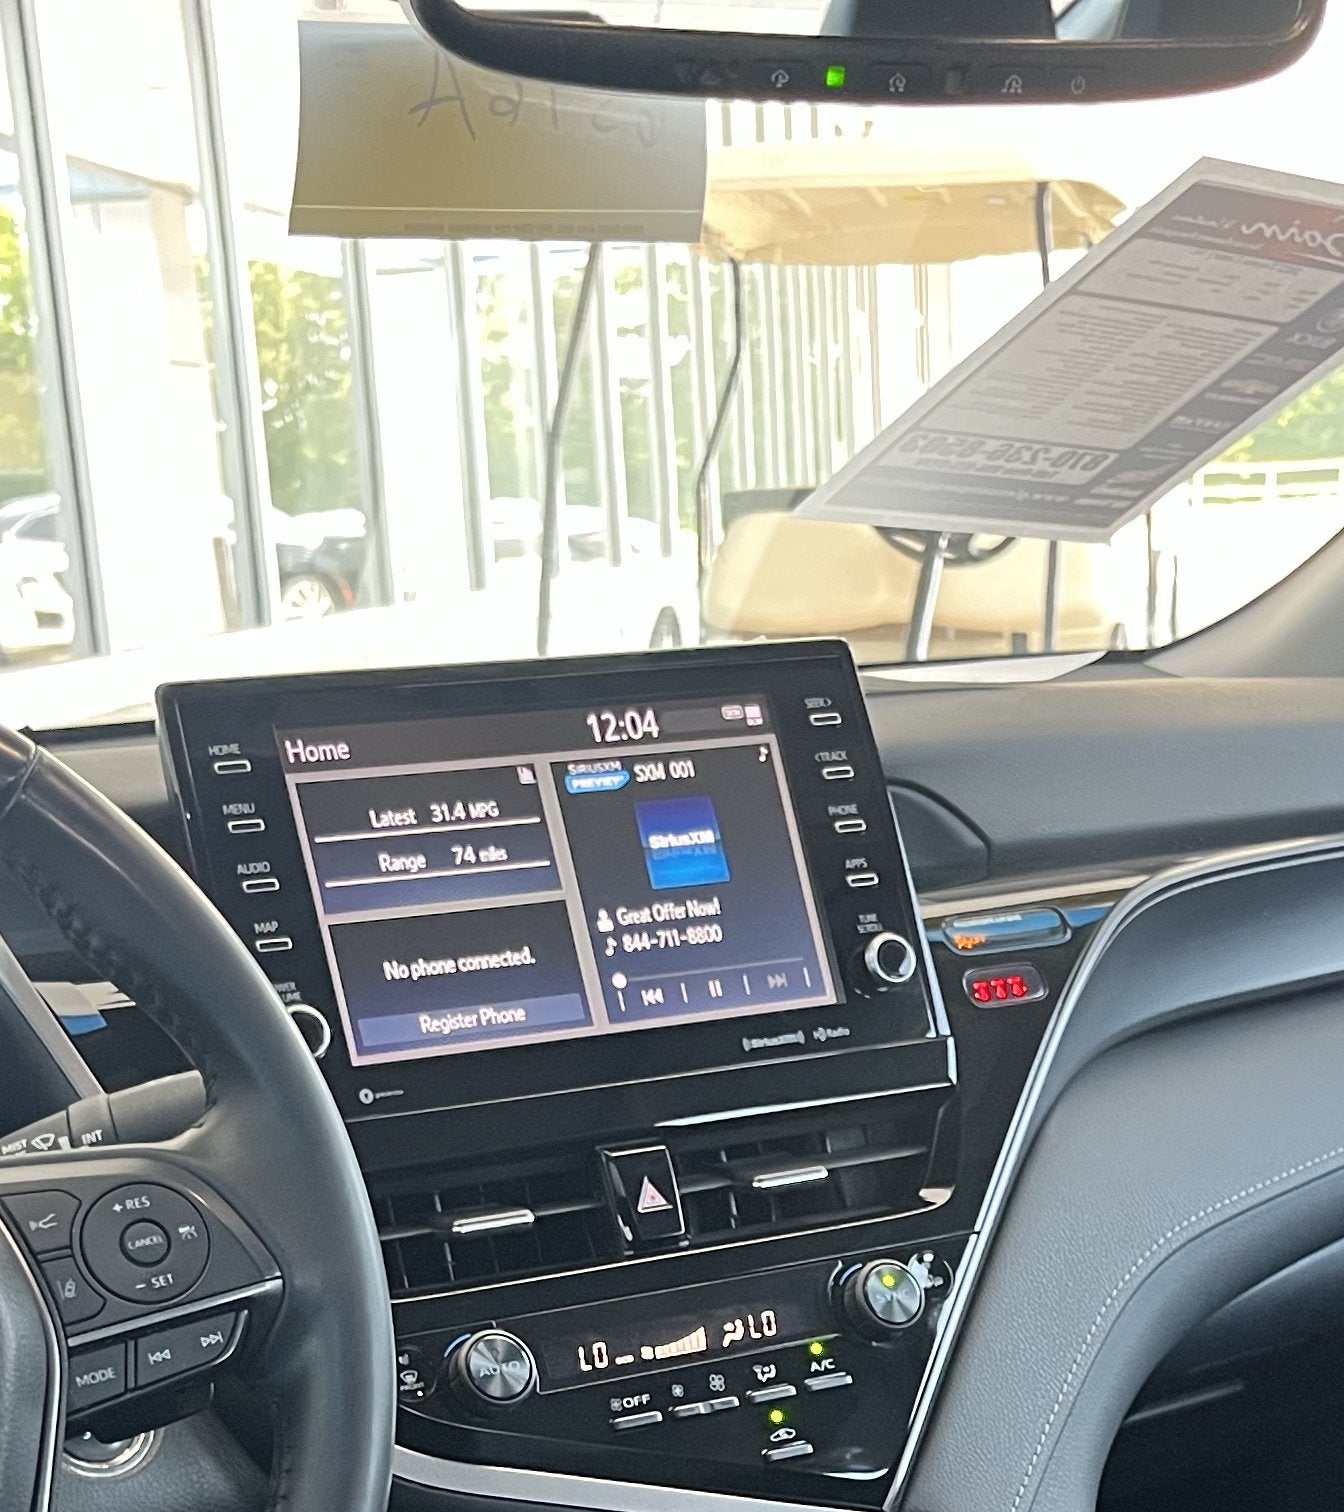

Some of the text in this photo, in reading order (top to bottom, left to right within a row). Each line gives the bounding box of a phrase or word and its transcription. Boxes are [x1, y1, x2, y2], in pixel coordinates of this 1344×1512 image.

[587, 708, 660, 743] 12:04
[208, 743, 241, 756] HOME
[284, 738, 351, 764] Home
[634, 760, 696, 783] SXM 001
[222, 803, 255, 815] MENU
[369, 800, 500, 829] Latest 31.4 MPG
[237, 861, 271, 875] AUDIO
[378, 851, 427, 873] Range
[451, 846, 476, 866] 74
[616, 896, 721, 926] Great Offer Now!
[254, 921, 278, 934] MAP
[383, 946, 536, 981] No phone connected.
[419, 1007, 526, 1034] Register Phone
[125, 1196, 151, 1210] RES
[151, 1274, 174, 1289] SET
[480, 1361, 521, 1378] AUTO
[810, 1358, 835, 1373] A/C
[75, 1367, 117, 1388] MODE
[623, 1393, 651, 1409] OFF
